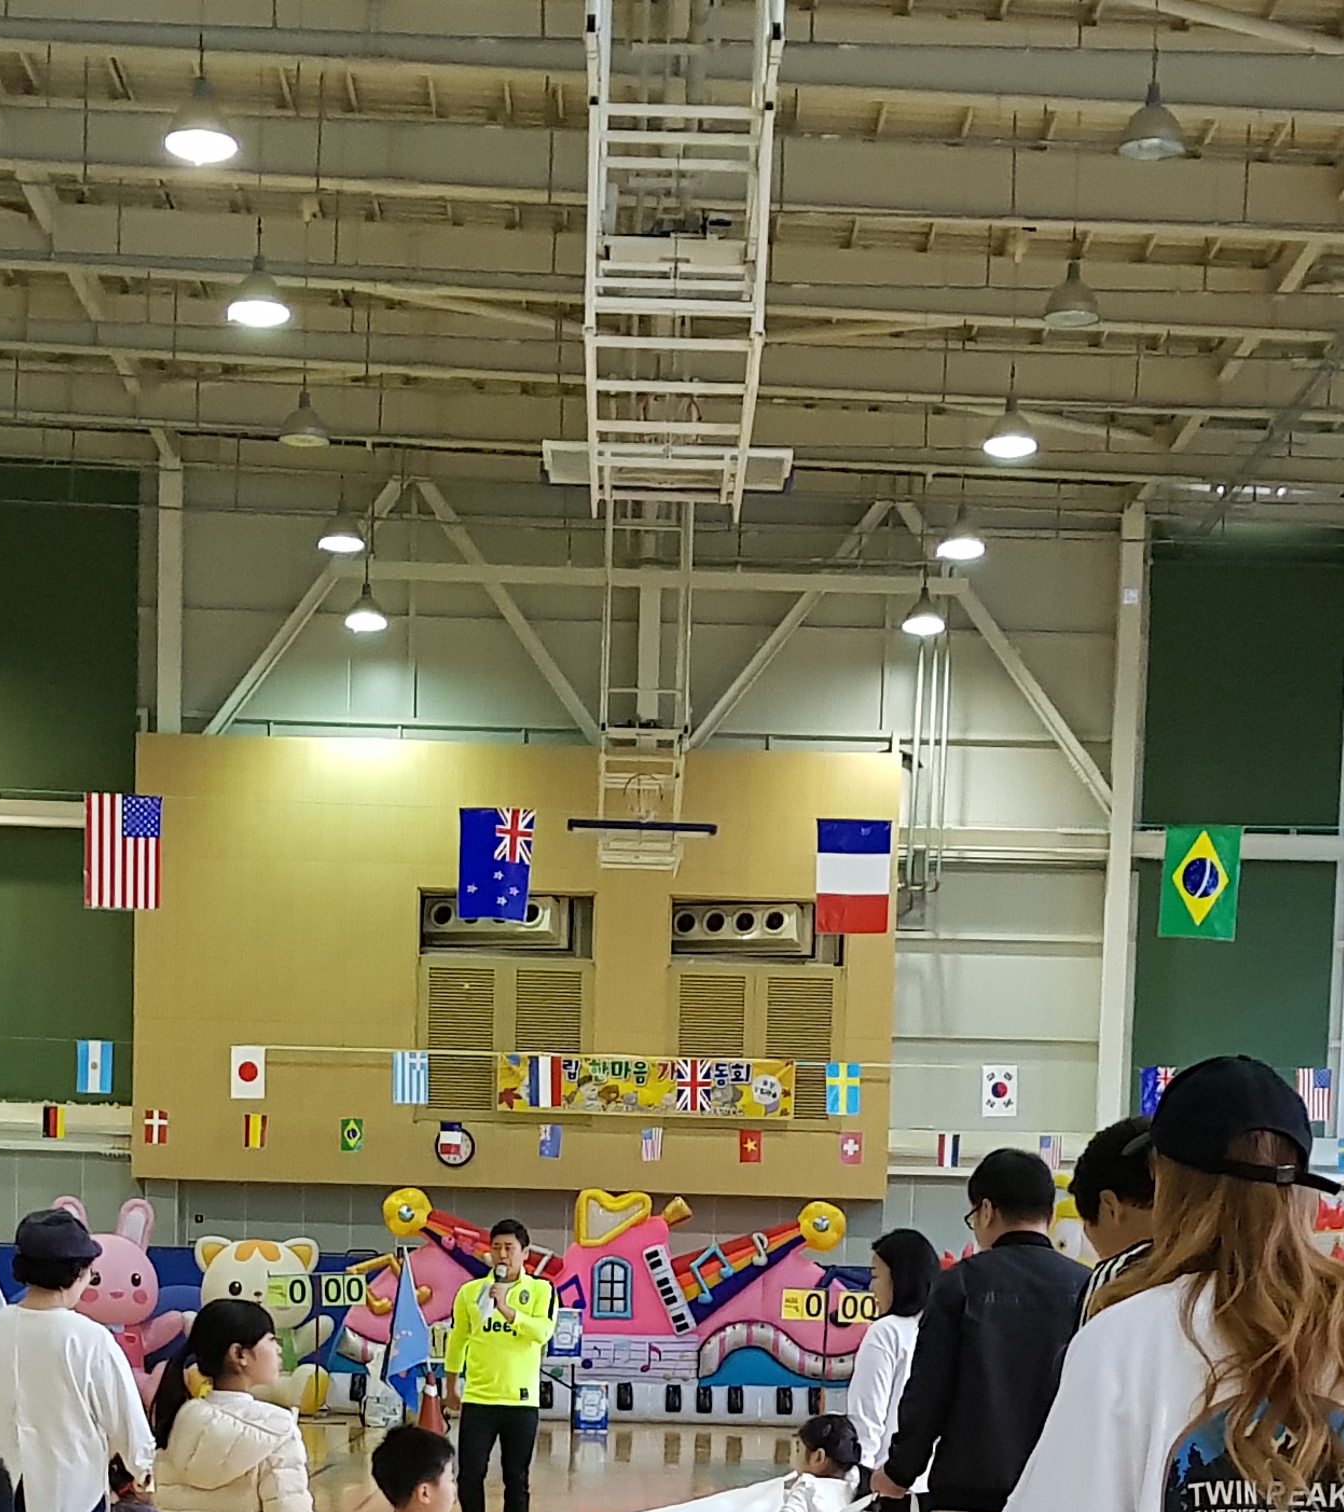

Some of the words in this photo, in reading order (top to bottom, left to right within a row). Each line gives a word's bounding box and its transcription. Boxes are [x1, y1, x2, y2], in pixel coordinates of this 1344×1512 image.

[588, 1060, 648, 1085] 한마음
[289, 1279, 306, 1304] 0
[806, 1293, 822, 1317] 0
[1187, 1479, 1258, 1507] TWIN
